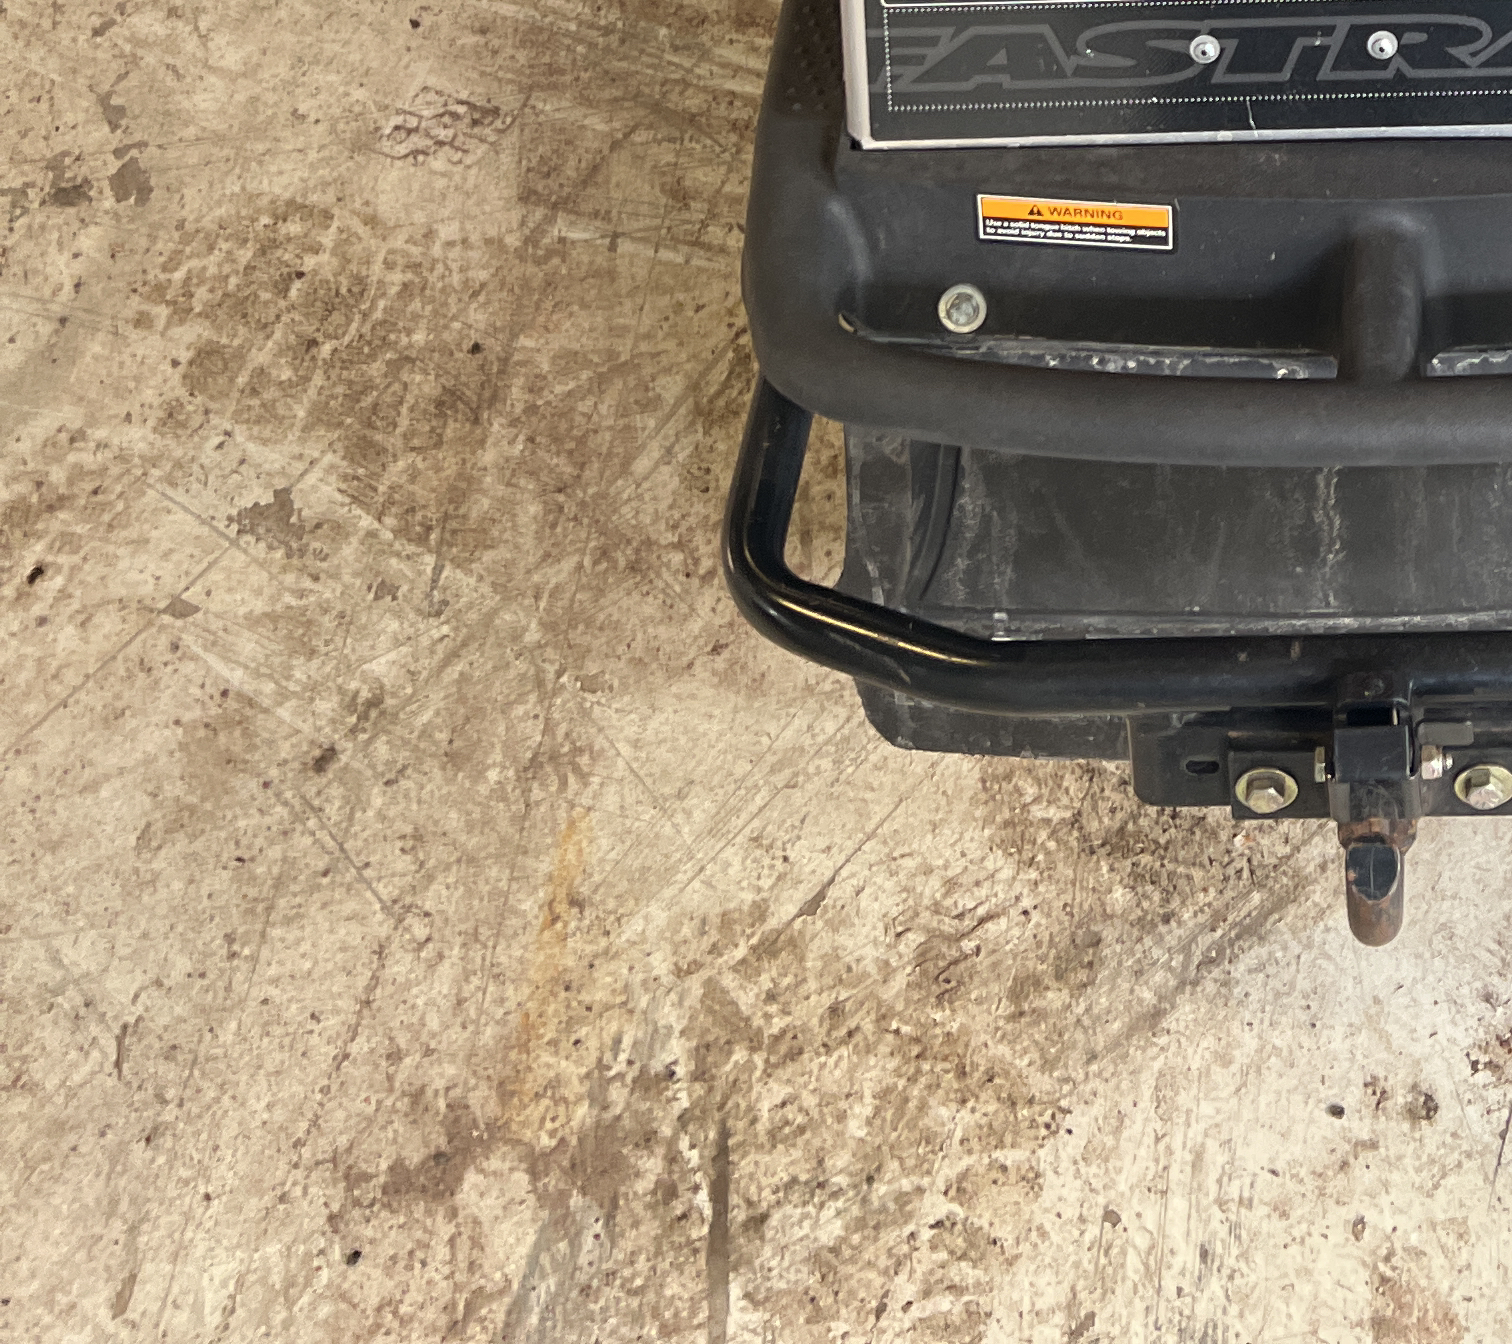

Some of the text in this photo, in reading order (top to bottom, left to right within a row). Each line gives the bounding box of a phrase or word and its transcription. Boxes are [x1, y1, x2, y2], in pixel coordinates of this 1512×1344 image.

[1047, 206, 1124, 221] WARNING
[986, 218, 1002, 228] Use
[1136, 228, 1166, 238] objects
